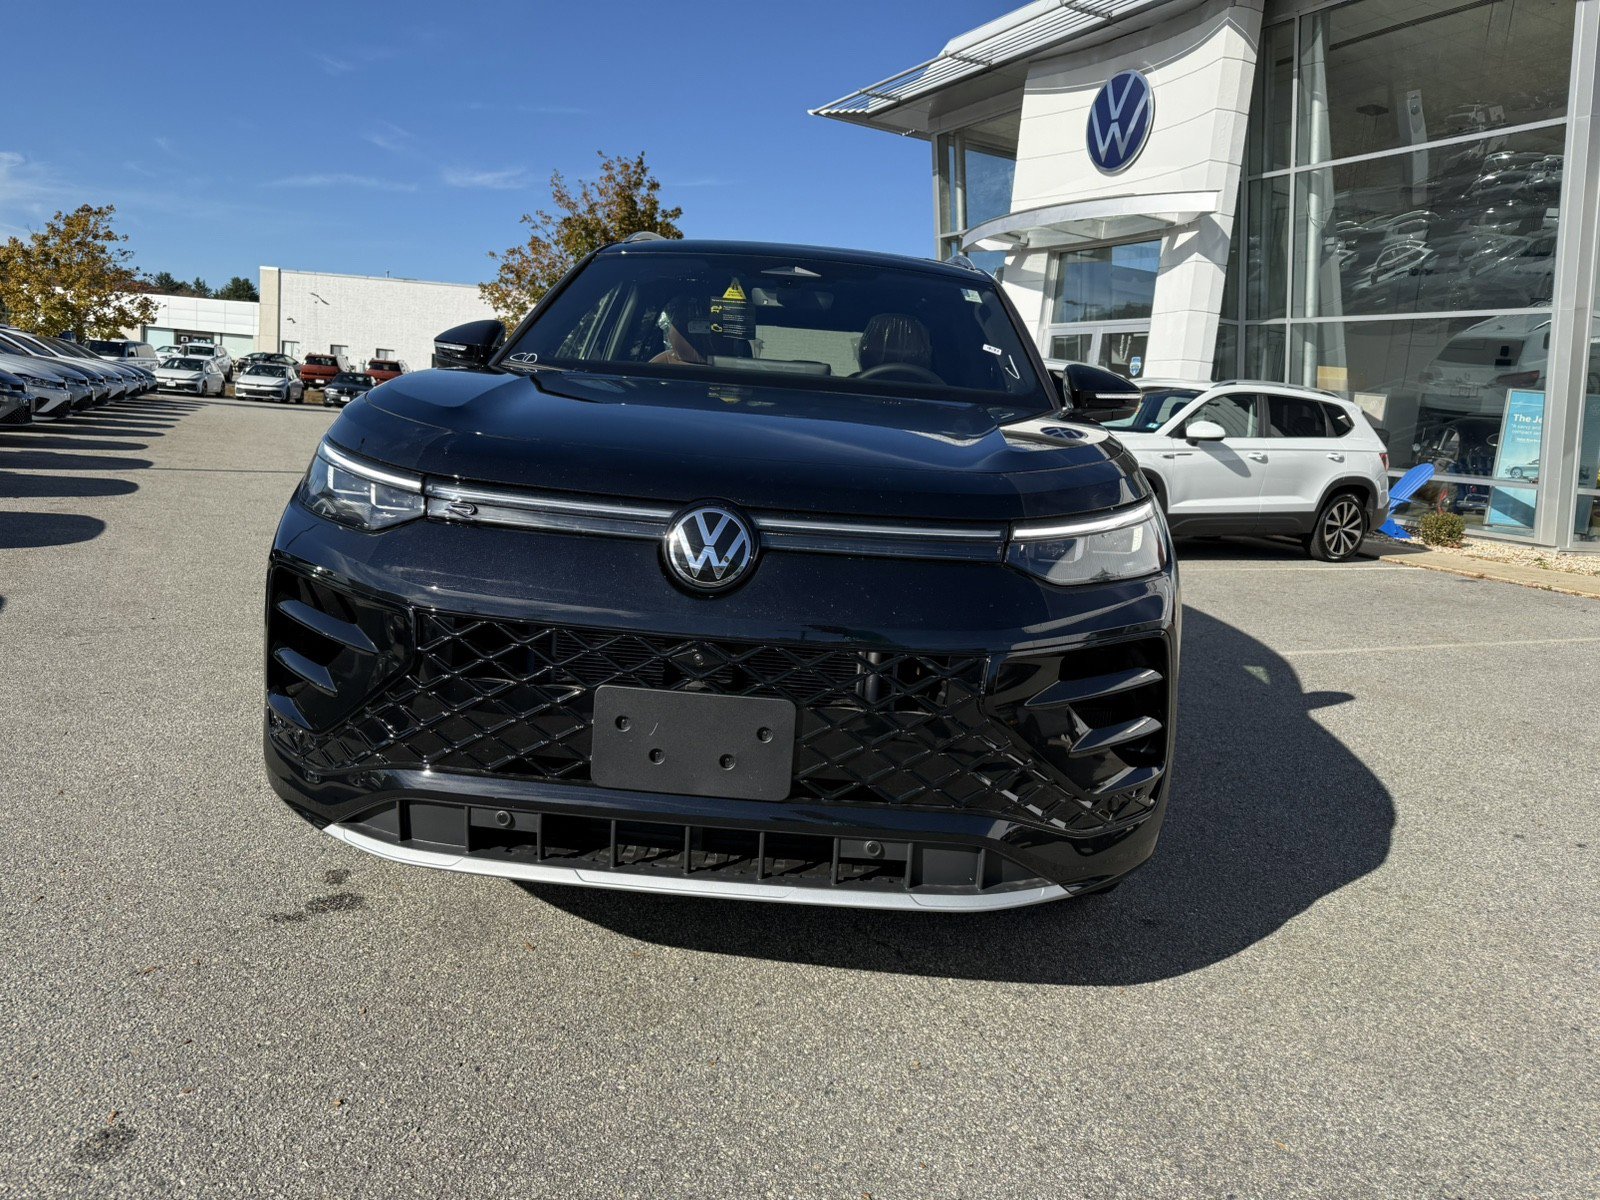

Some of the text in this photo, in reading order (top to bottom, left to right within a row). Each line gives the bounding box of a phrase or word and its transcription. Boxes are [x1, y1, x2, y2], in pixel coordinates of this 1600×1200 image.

[1089, 71, 1151, 165] VW
[1513, 413, 1531, 423] The
[673, 509, 749, 582] VW
